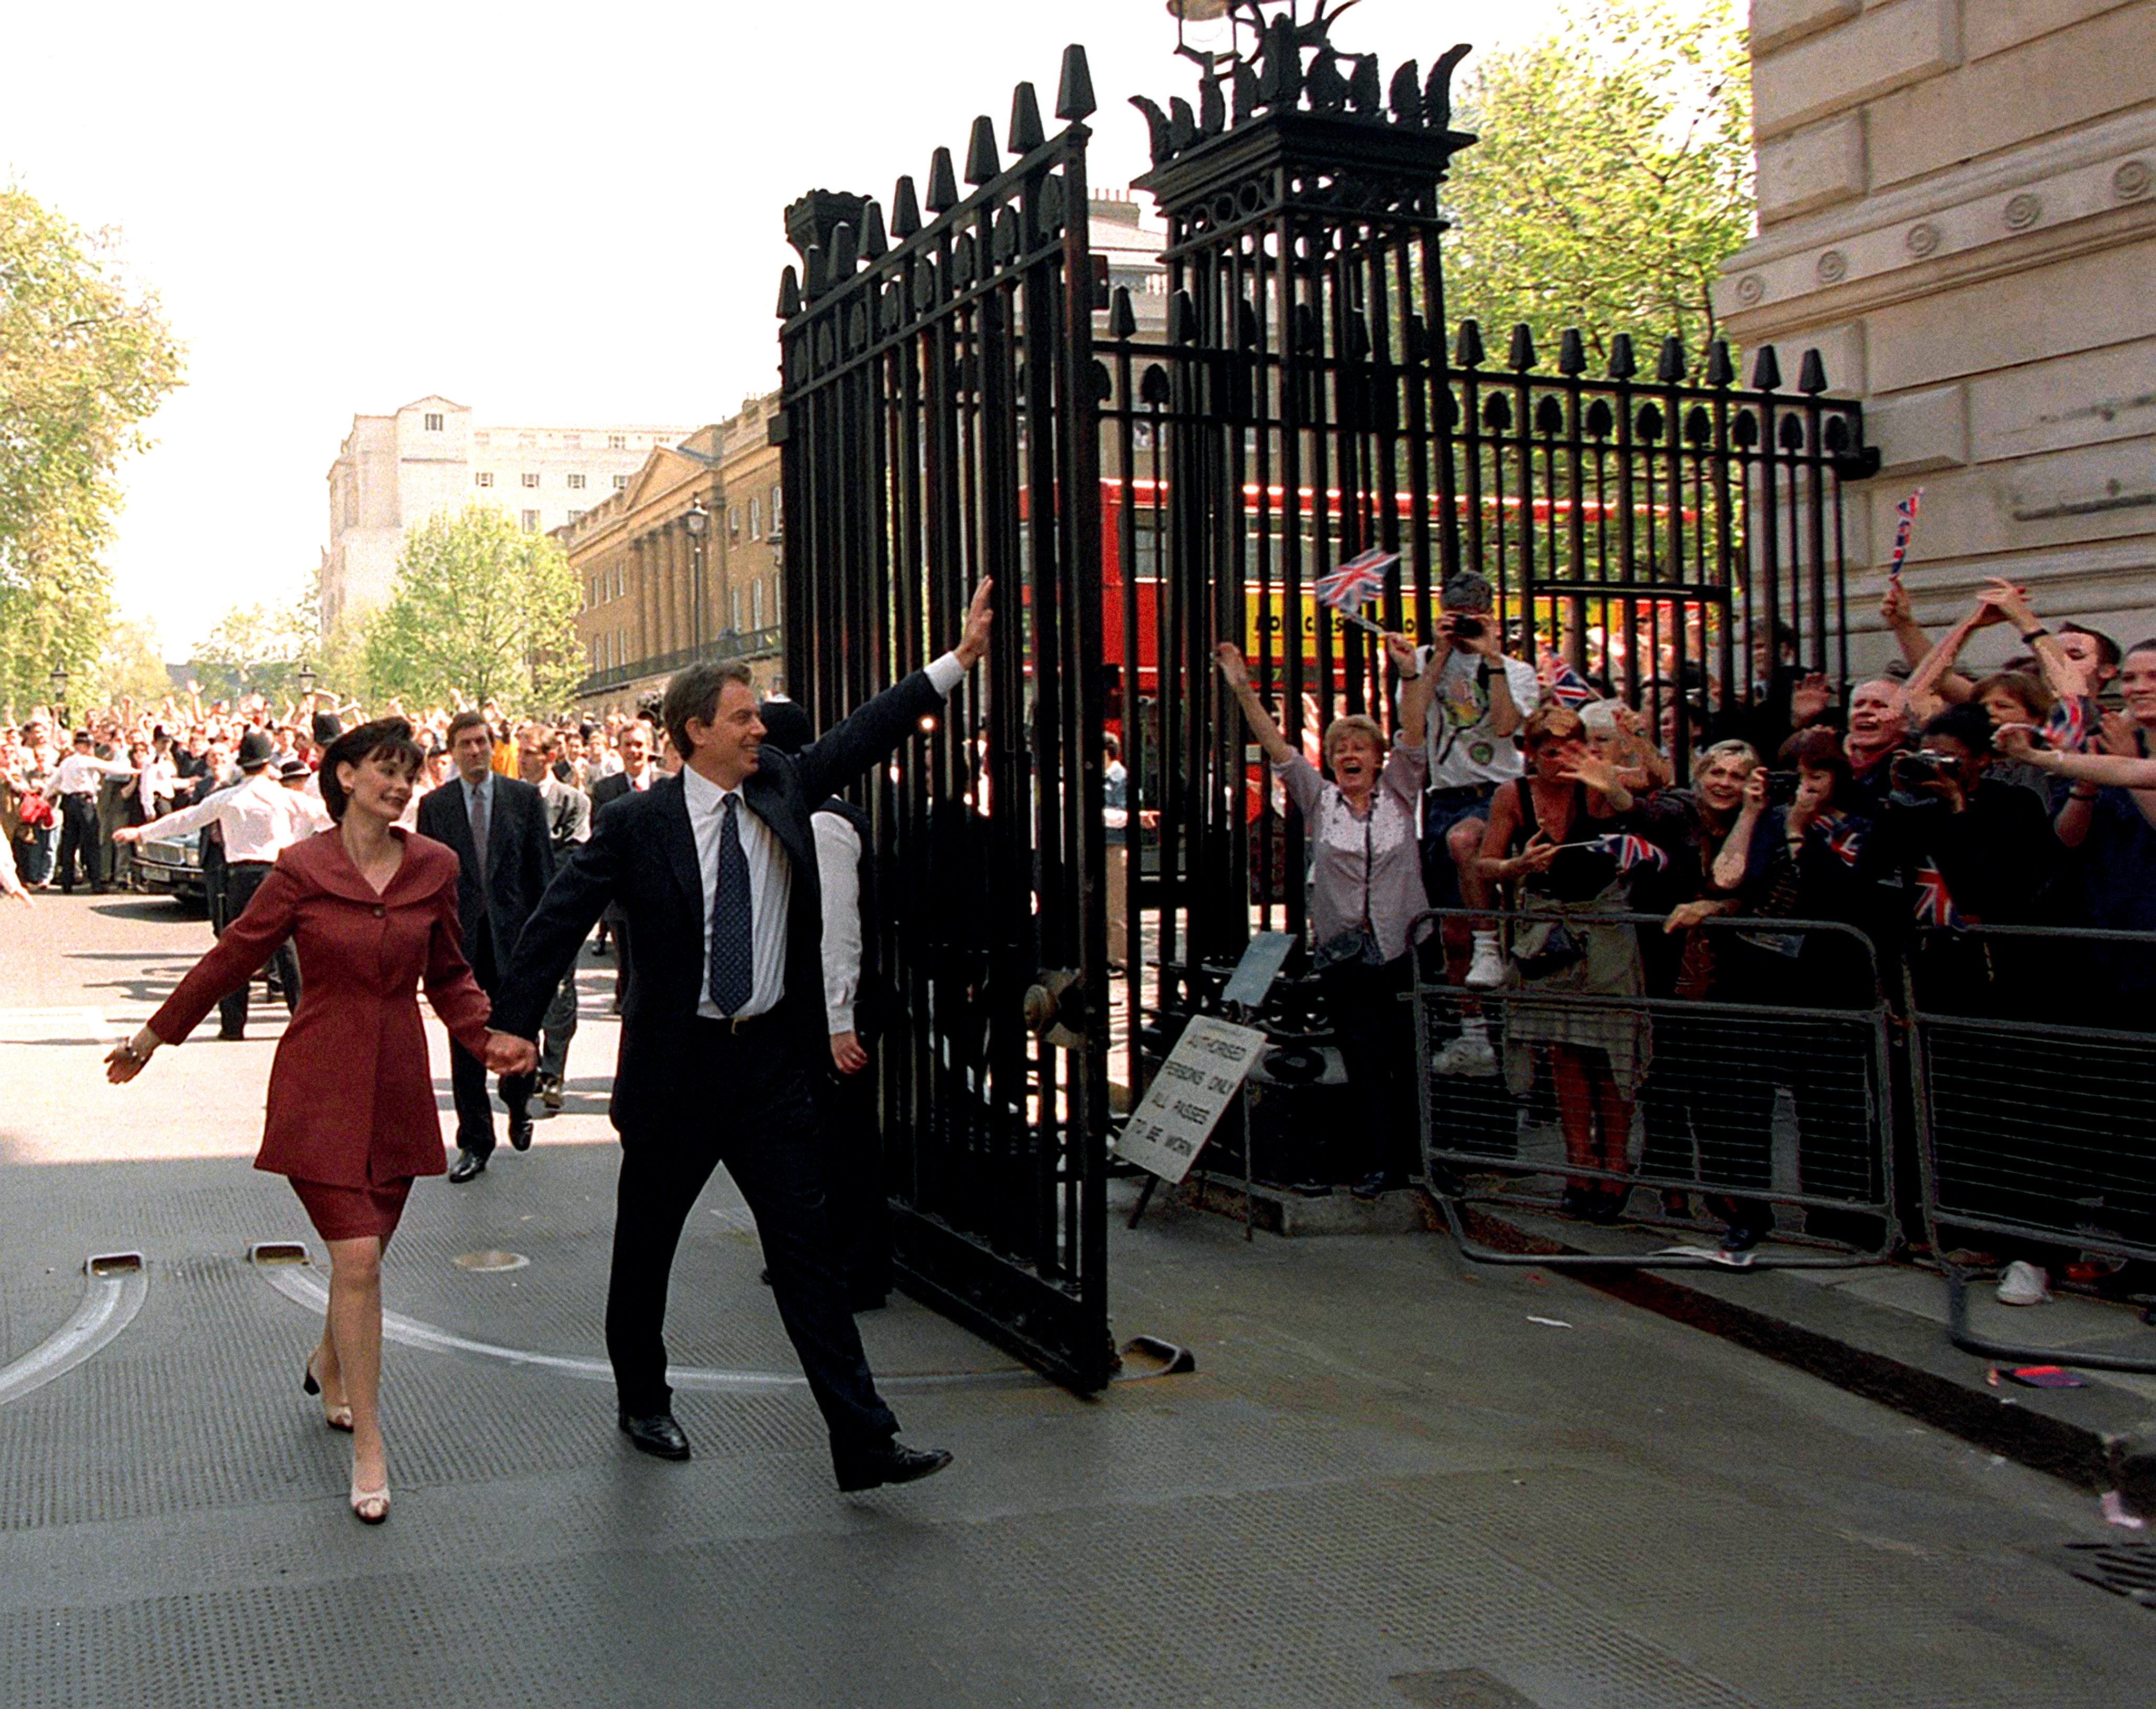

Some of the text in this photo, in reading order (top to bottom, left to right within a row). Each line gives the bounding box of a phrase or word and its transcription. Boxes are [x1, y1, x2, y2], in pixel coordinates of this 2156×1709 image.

[1187, 1035, 1246, 1062] ATHORISED
[1165, 1060, 1205, 1085] PERSONS
[1146, 1125, 1163, 1143] BE
